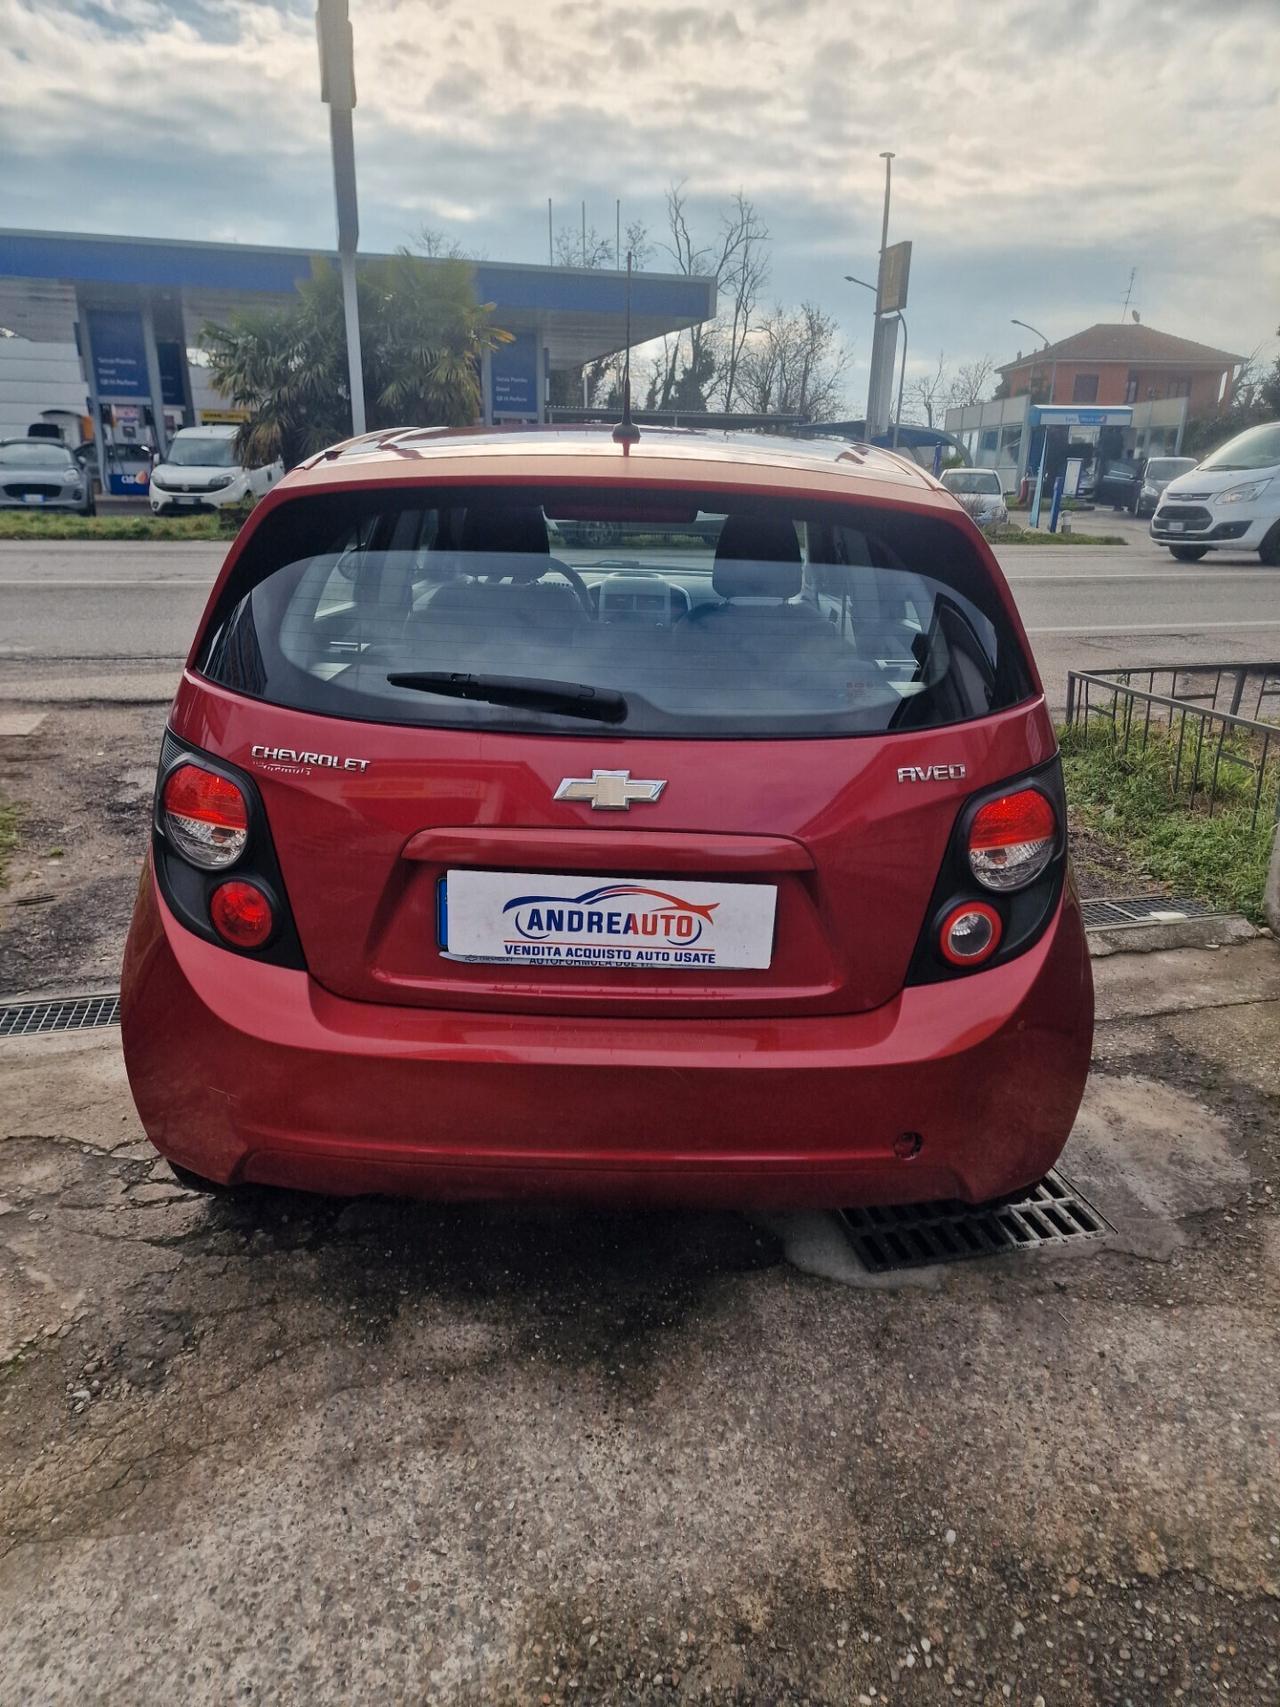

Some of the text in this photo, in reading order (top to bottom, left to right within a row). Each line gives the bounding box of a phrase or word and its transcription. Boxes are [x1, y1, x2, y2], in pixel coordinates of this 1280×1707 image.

[251, 745, 371, 772] CHEVROLET
[897, 764, 966, 783] AVEO
[526, 908, 694, 938] ANDREAUTO
[504, 945, 716, 964] VENDITA ACQUISTO AUTO USATE
